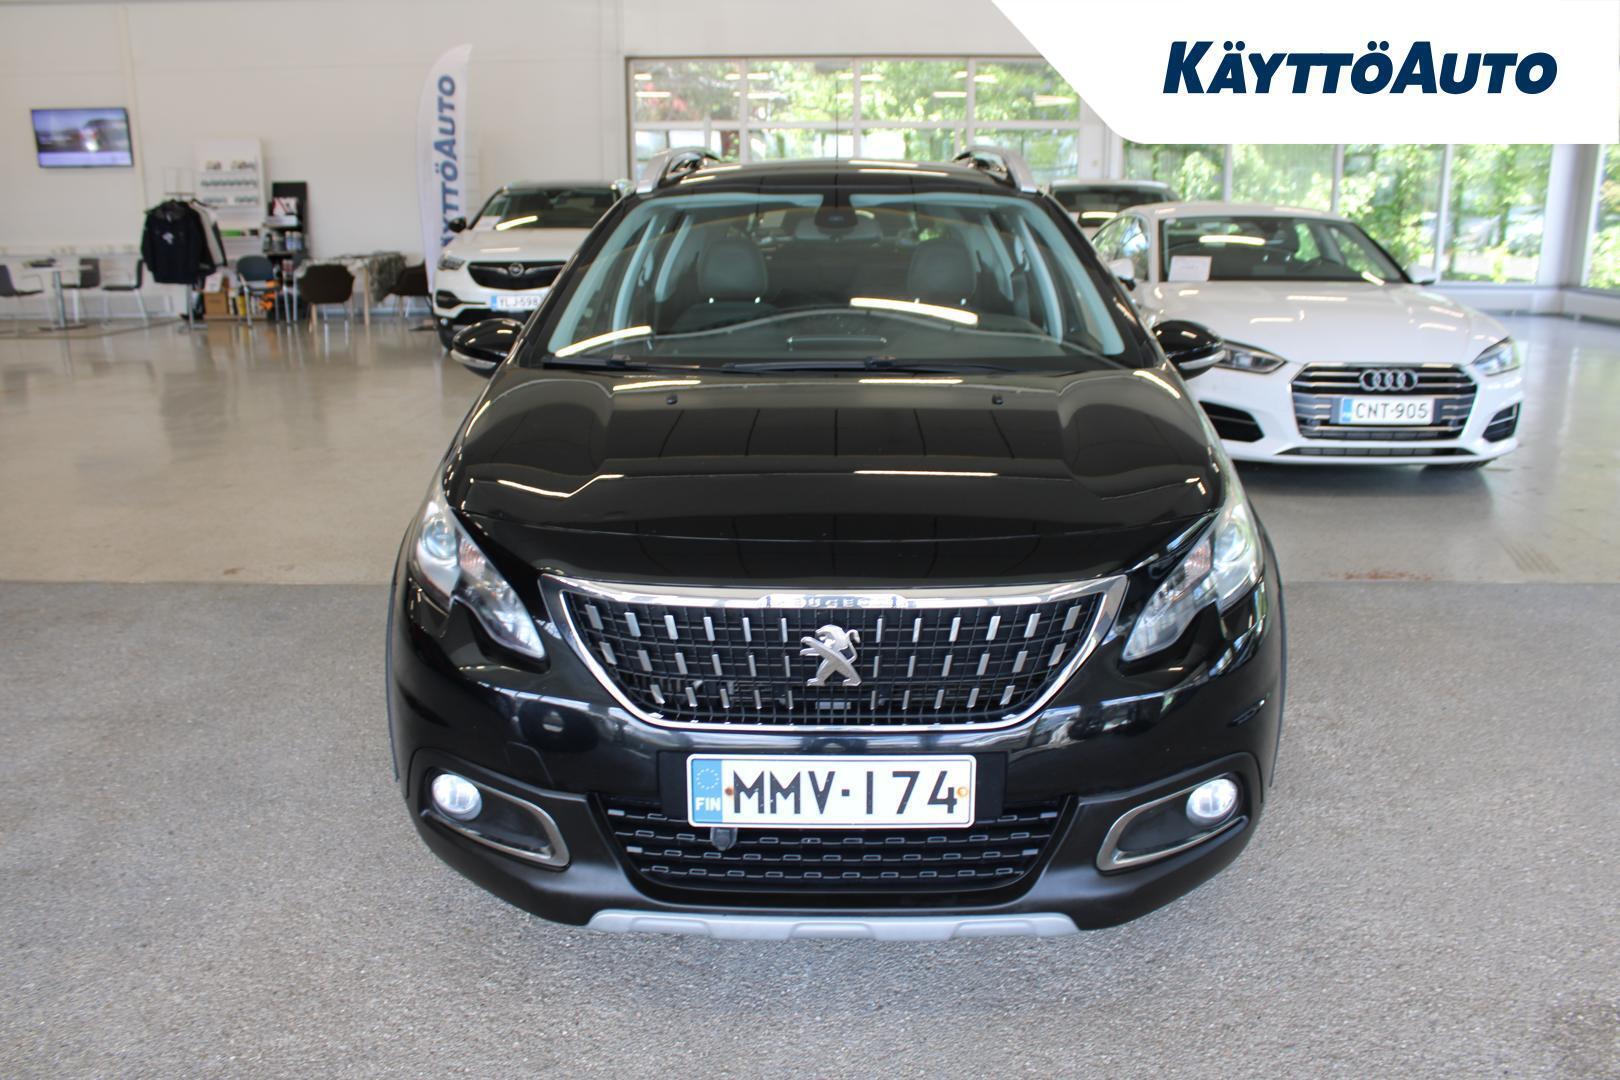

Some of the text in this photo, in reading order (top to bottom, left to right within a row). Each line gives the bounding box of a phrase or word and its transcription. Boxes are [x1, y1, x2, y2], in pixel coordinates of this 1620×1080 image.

[1356, 402, 1428, 419] CNT-905
[695, 770, 957, 815] FIN MMV-174
